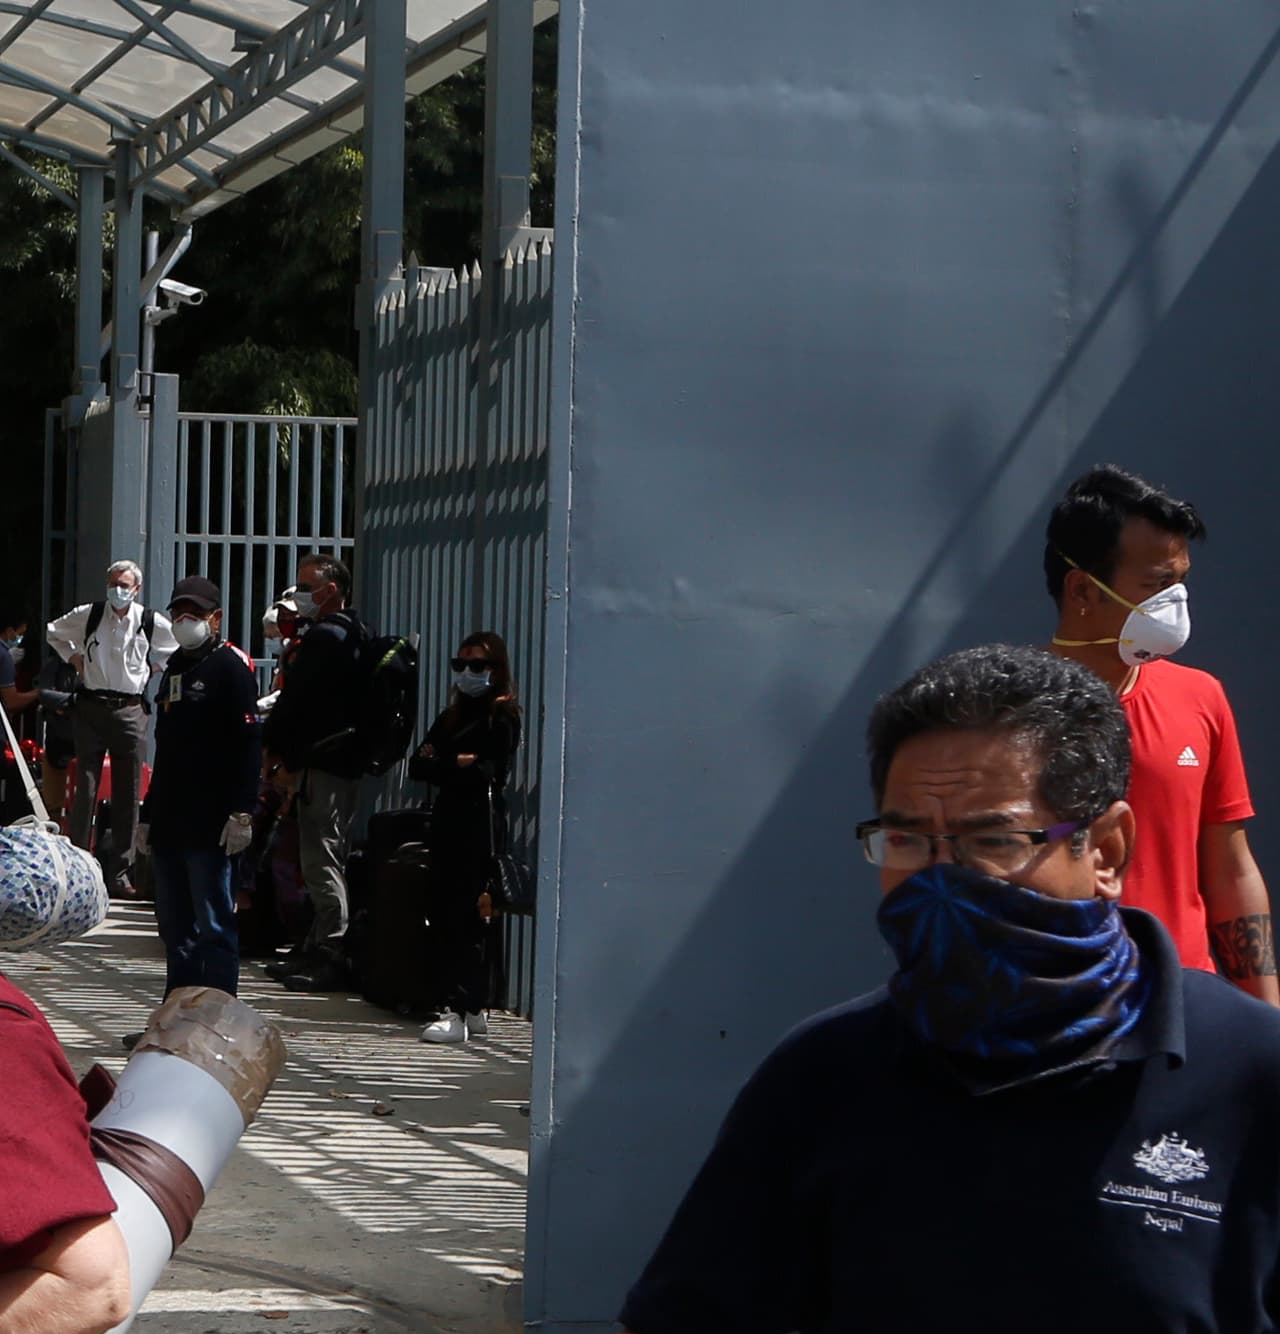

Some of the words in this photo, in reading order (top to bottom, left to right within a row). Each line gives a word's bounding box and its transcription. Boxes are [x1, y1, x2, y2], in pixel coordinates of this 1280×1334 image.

[1103, 1181, 1168, 1203] Australian
[1171, 1190, 1223, 1215] Embassy
[1144, 1211, 1184, 1232] Nepal
